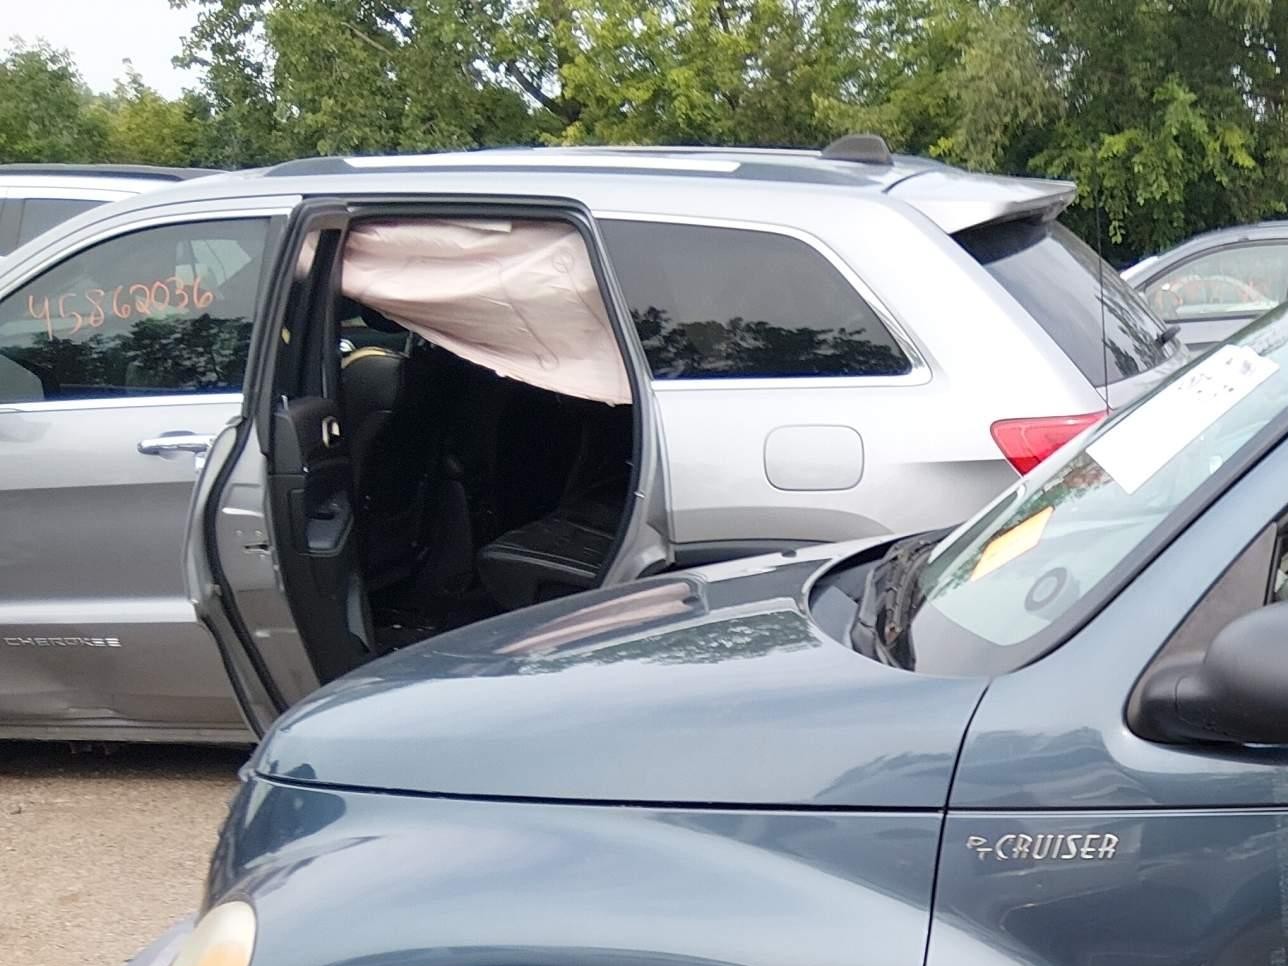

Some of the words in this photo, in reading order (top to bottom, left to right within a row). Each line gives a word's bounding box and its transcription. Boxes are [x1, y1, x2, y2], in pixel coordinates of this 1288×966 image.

[27, 277, 214, 340] 45862036
[966, 835, 993, 861] PT
[995, 834, 1120, 860] CRUISER
